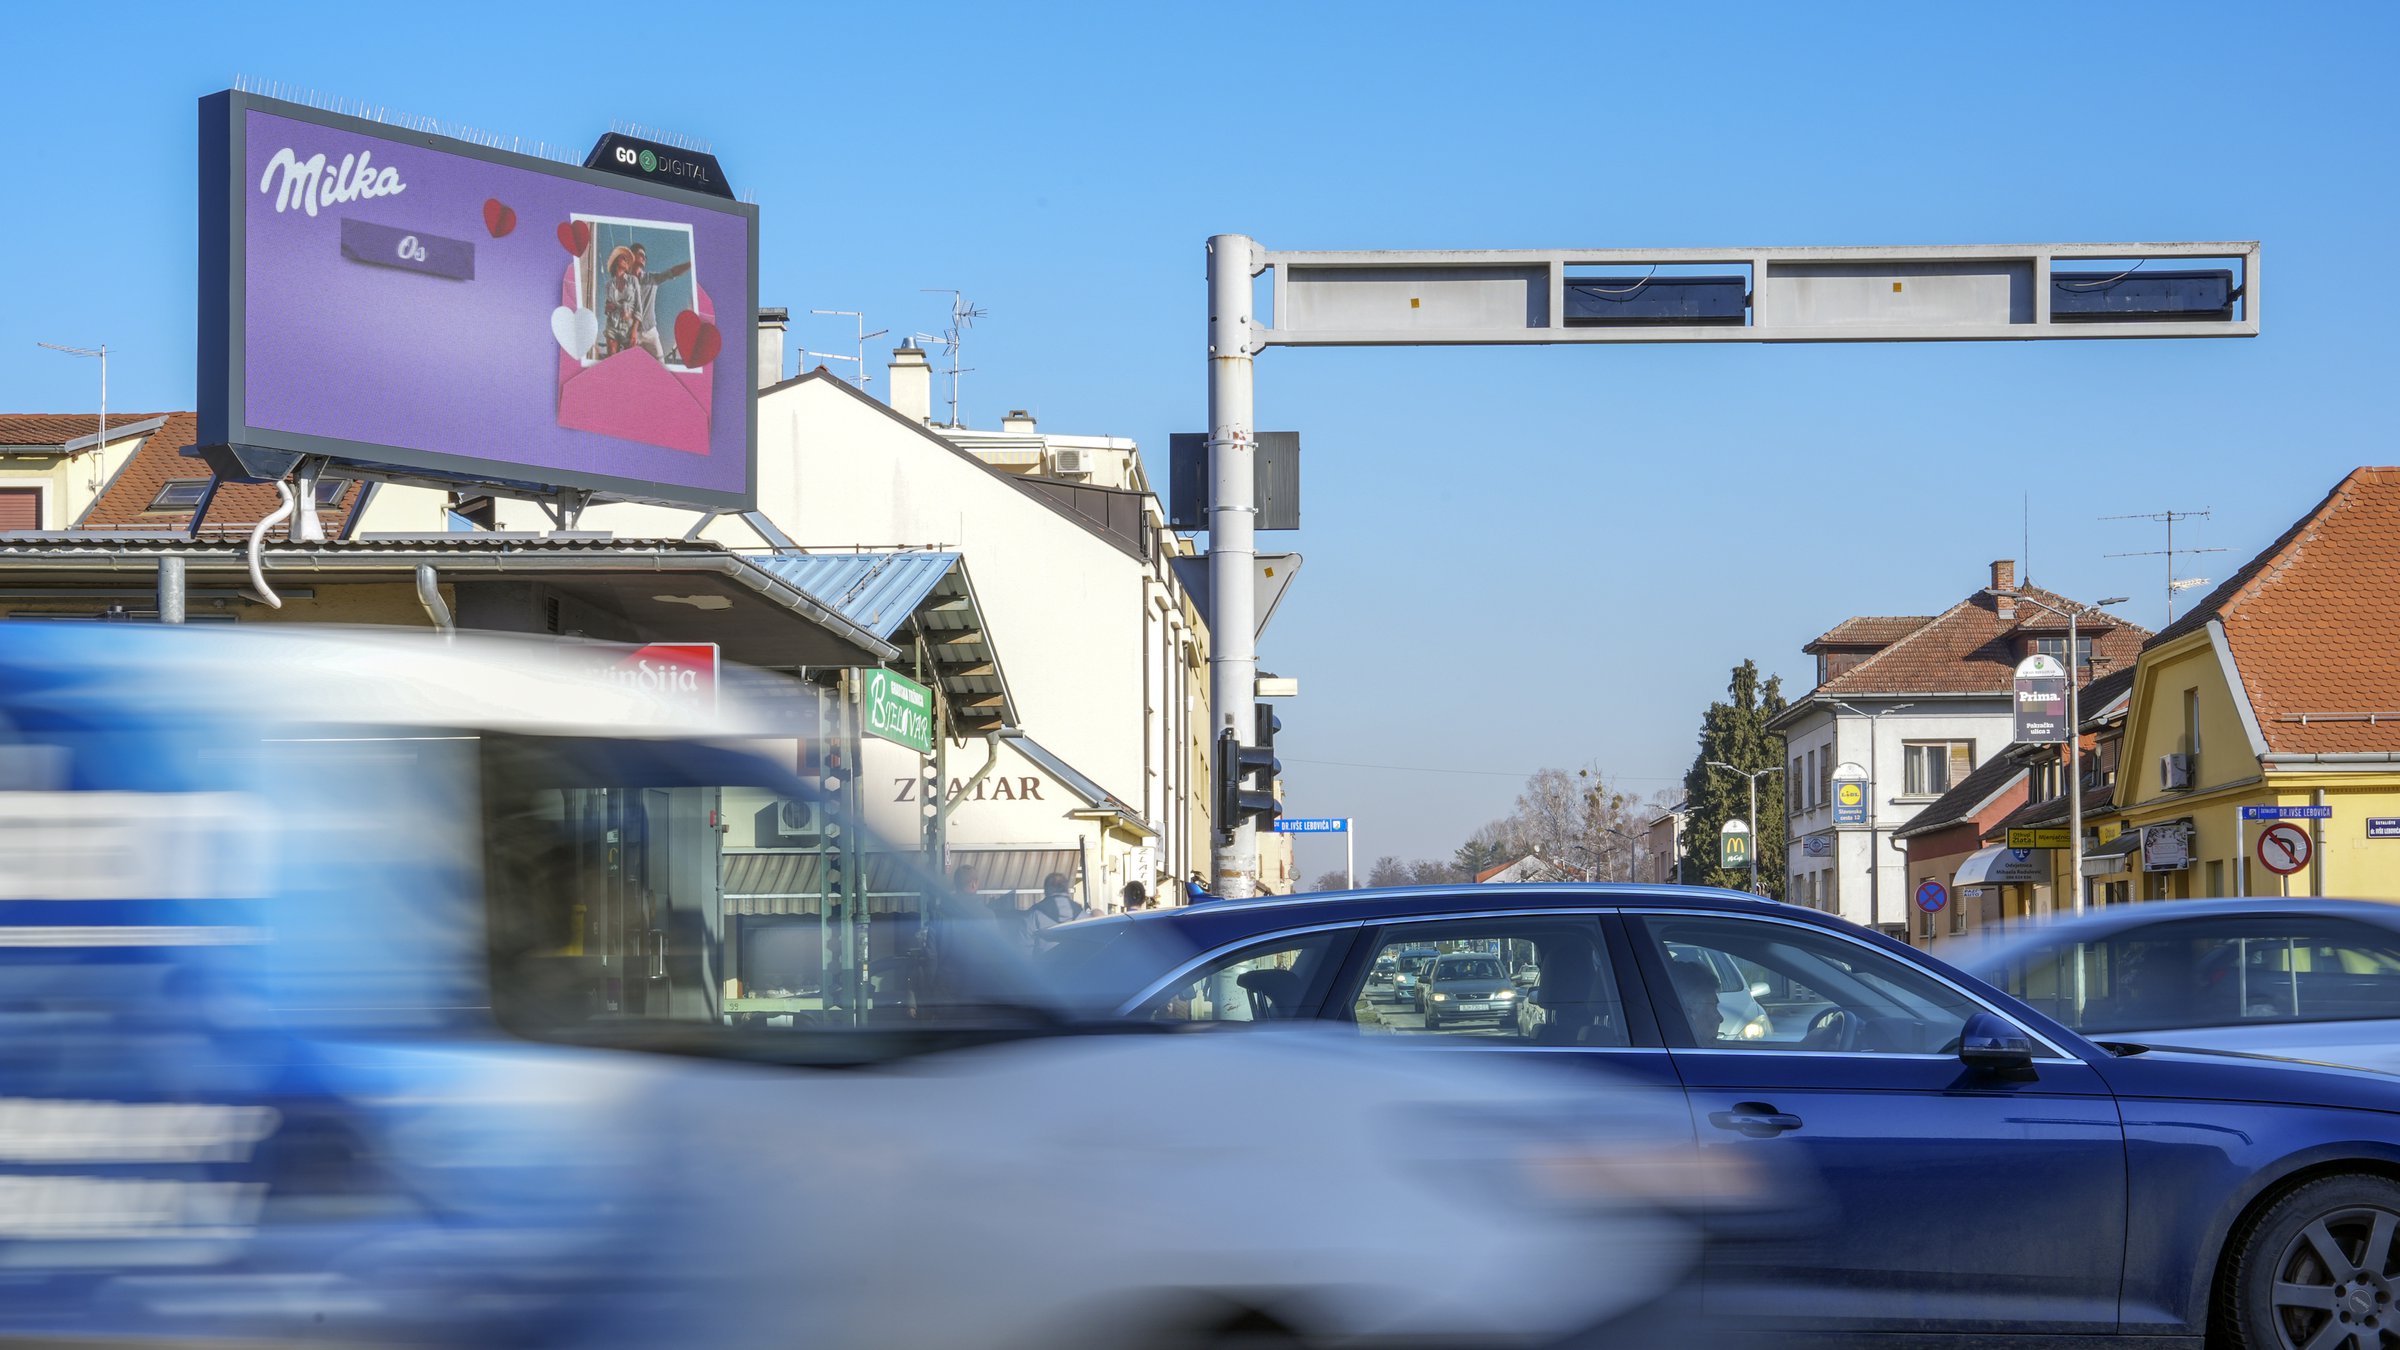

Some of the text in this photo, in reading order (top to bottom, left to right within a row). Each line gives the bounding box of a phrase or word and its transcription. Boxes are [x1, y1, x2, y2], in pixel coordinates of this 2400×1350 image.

[615, 146, 637, 165] GO
[659, 156, 710, 182] DIGITAL
[260, 148, 406, 217] Milka
[2019, 691, 2061, 702] Prima.
[893, 776, 1045, 802] ZATAR
[2303, 806, 2331, 817] LEBOVIĆA
